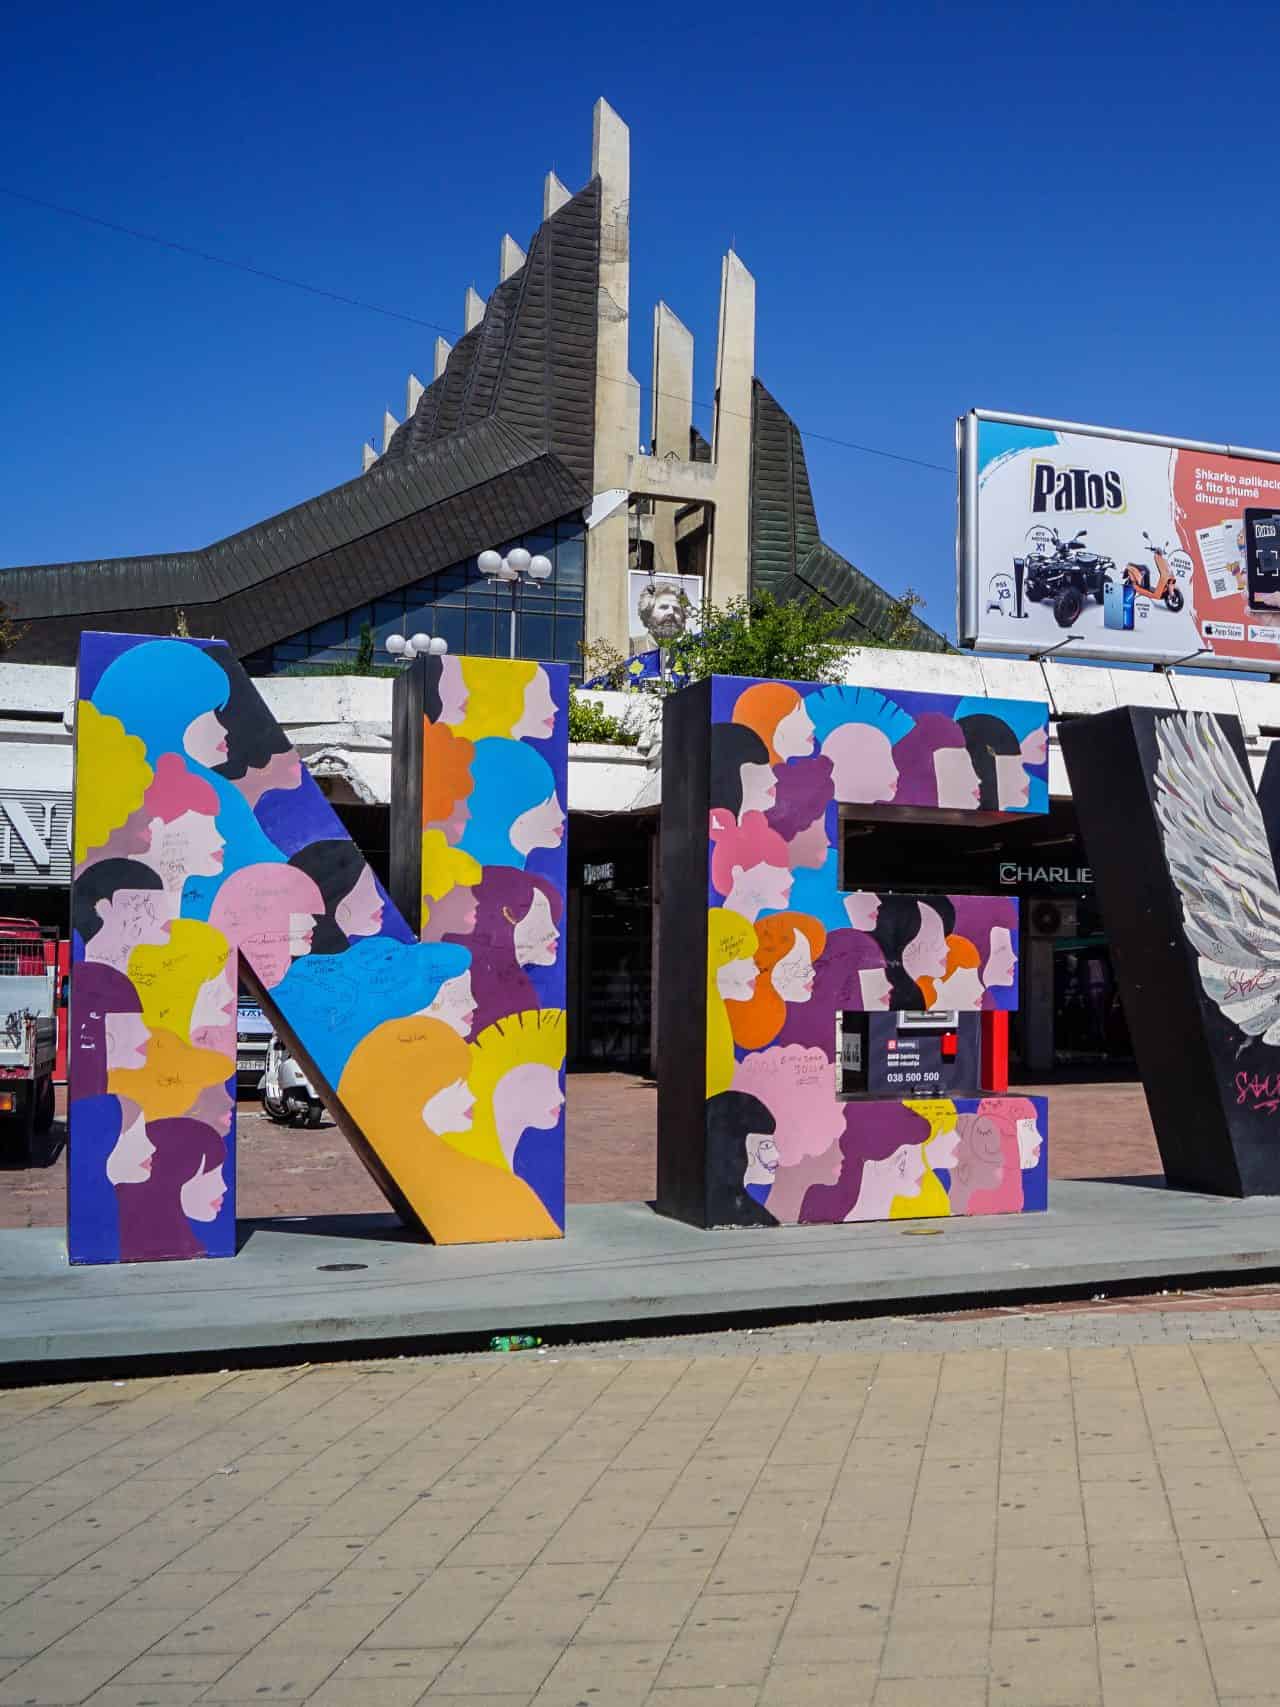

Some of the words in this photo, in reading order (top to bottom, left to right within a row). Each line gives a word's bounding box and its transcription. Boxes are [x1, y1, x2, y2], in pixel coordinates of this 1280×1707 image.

[1195, 468, 1236, 484] Shkarko
[1195, 480, 1203, 491] &
[1206, 482, 1223, 493] fito
[1226, 485, 1259, 498] shumë
[1195, 492, 1239, 508] dhurata!
[1000, 862, 1096, 885] CHARLIE
[905, 1072, 921, 1082] 500
[923, 1072, 940, 1081] 500
